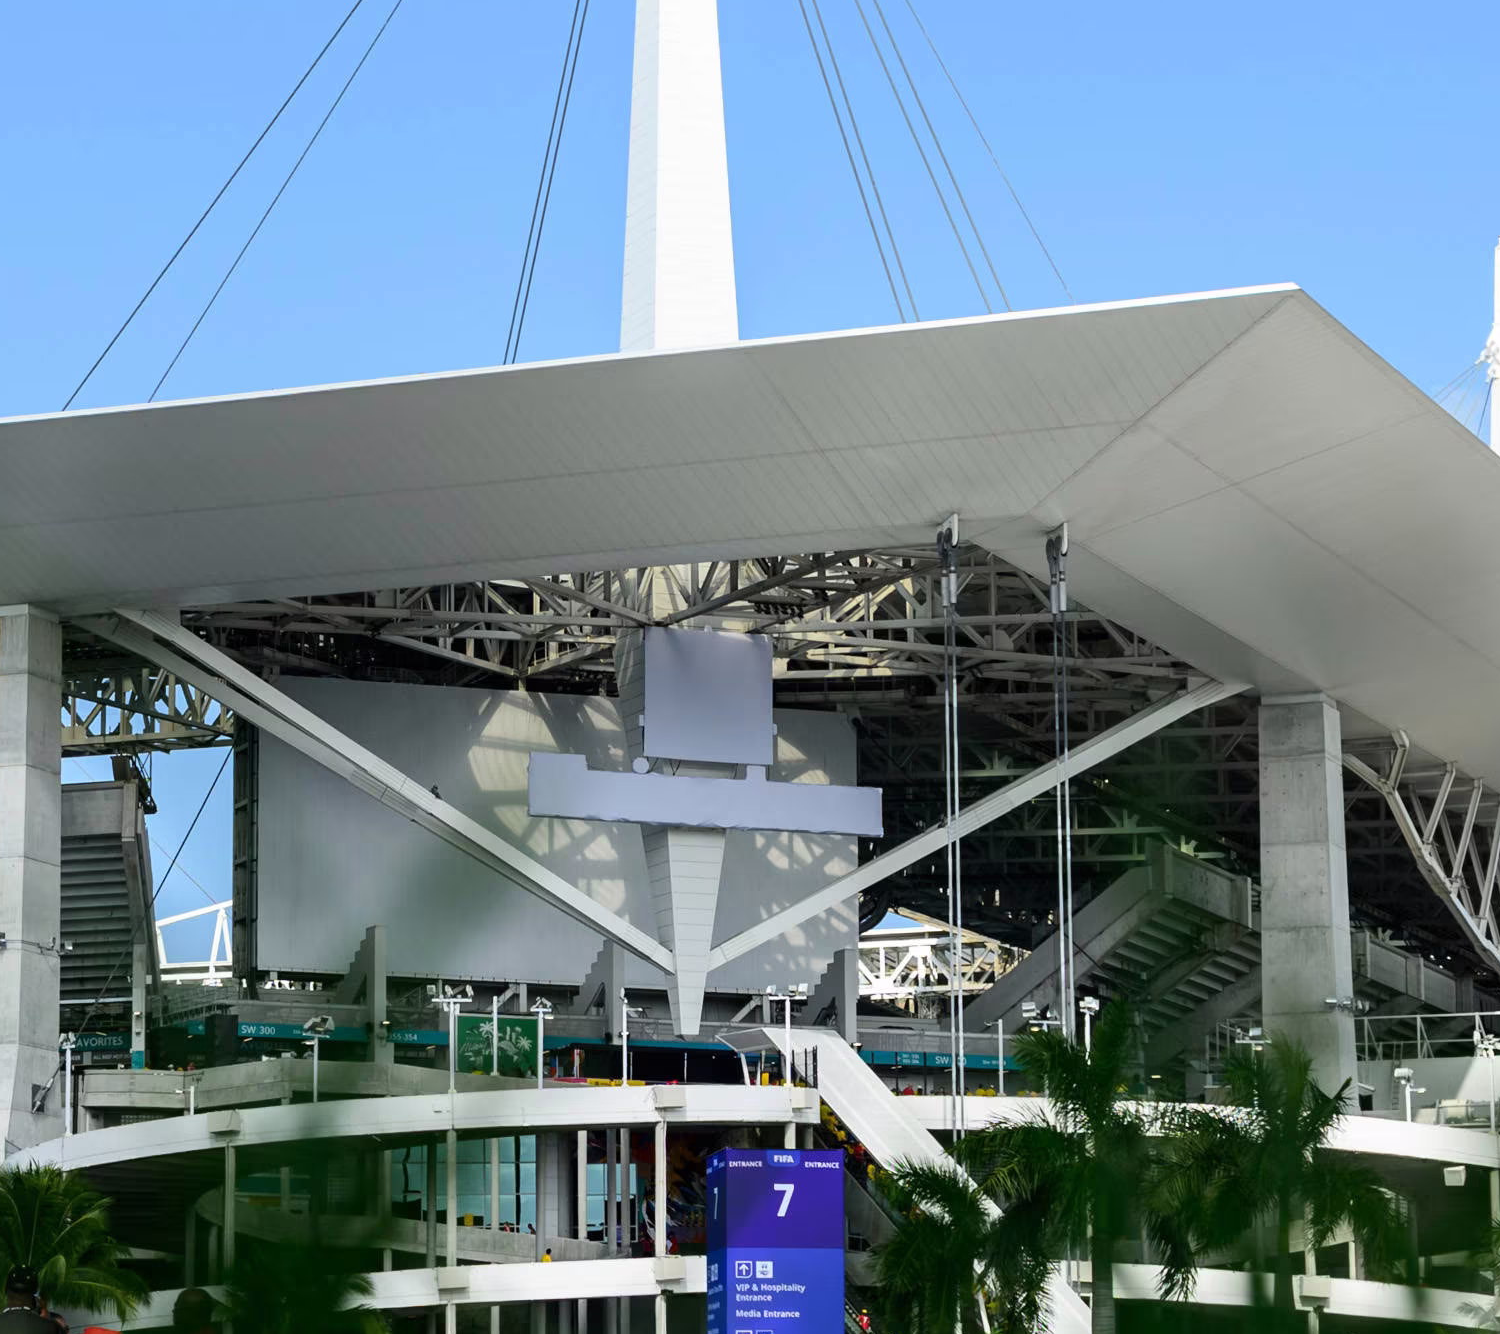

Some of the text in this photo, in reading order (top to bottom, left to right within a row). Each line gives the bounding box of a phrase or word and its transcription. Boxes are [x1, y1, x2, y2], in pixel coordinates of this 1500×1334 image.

[241, 1025, 276, 1035] SW 300
[74, 1035, 124, 1047] AVORITES
[935, 1055, 949, 1065] SW
[773, 1155, 794, 1163] FIFA
[729, 1160, 763, 1168] ENTRANCE
[804, 1161, 840, 1169] ENTRANCE
[773, 1183, 795, 1217] 7
[736, 1283, 806, 1294] VIP & Hospitality
[736, 1293, 773, 1302] Entrance
[735, 1309, 801, 1318] Media Entrance
